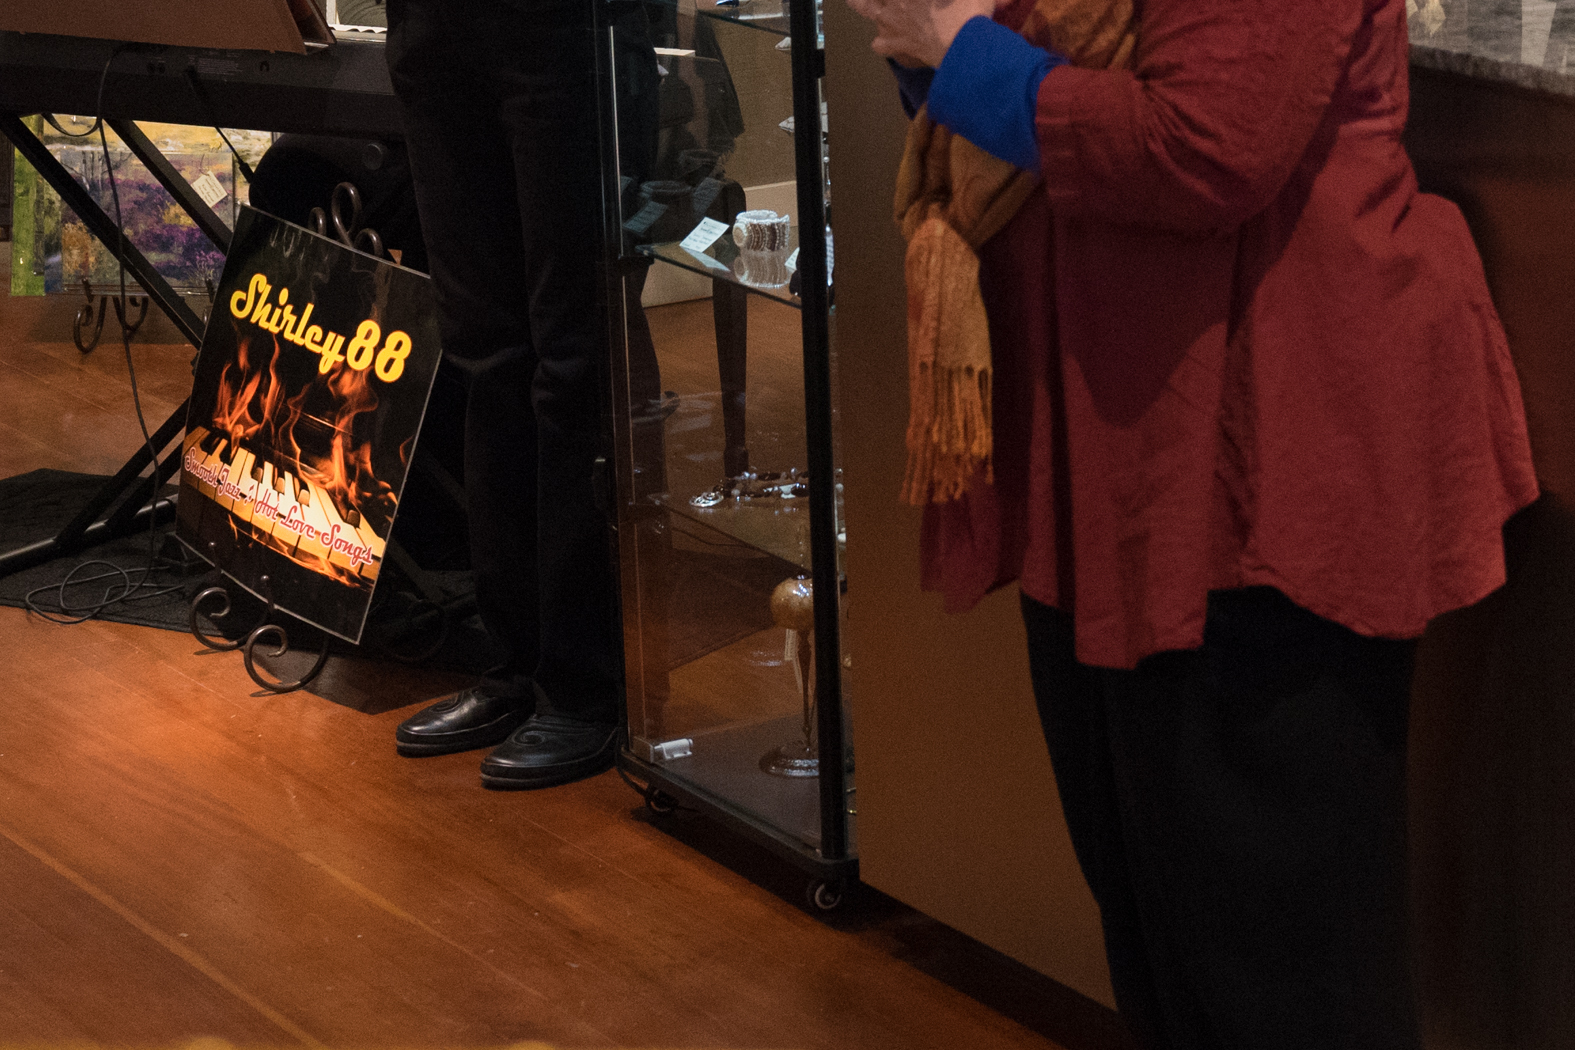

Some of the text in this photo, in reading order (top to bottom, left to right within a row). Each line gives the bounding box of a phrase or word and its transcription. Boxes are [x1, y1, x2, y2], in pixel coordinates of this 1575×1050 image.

[184, 447, 374, 566] Smooth Jazz Hot Love Songs
